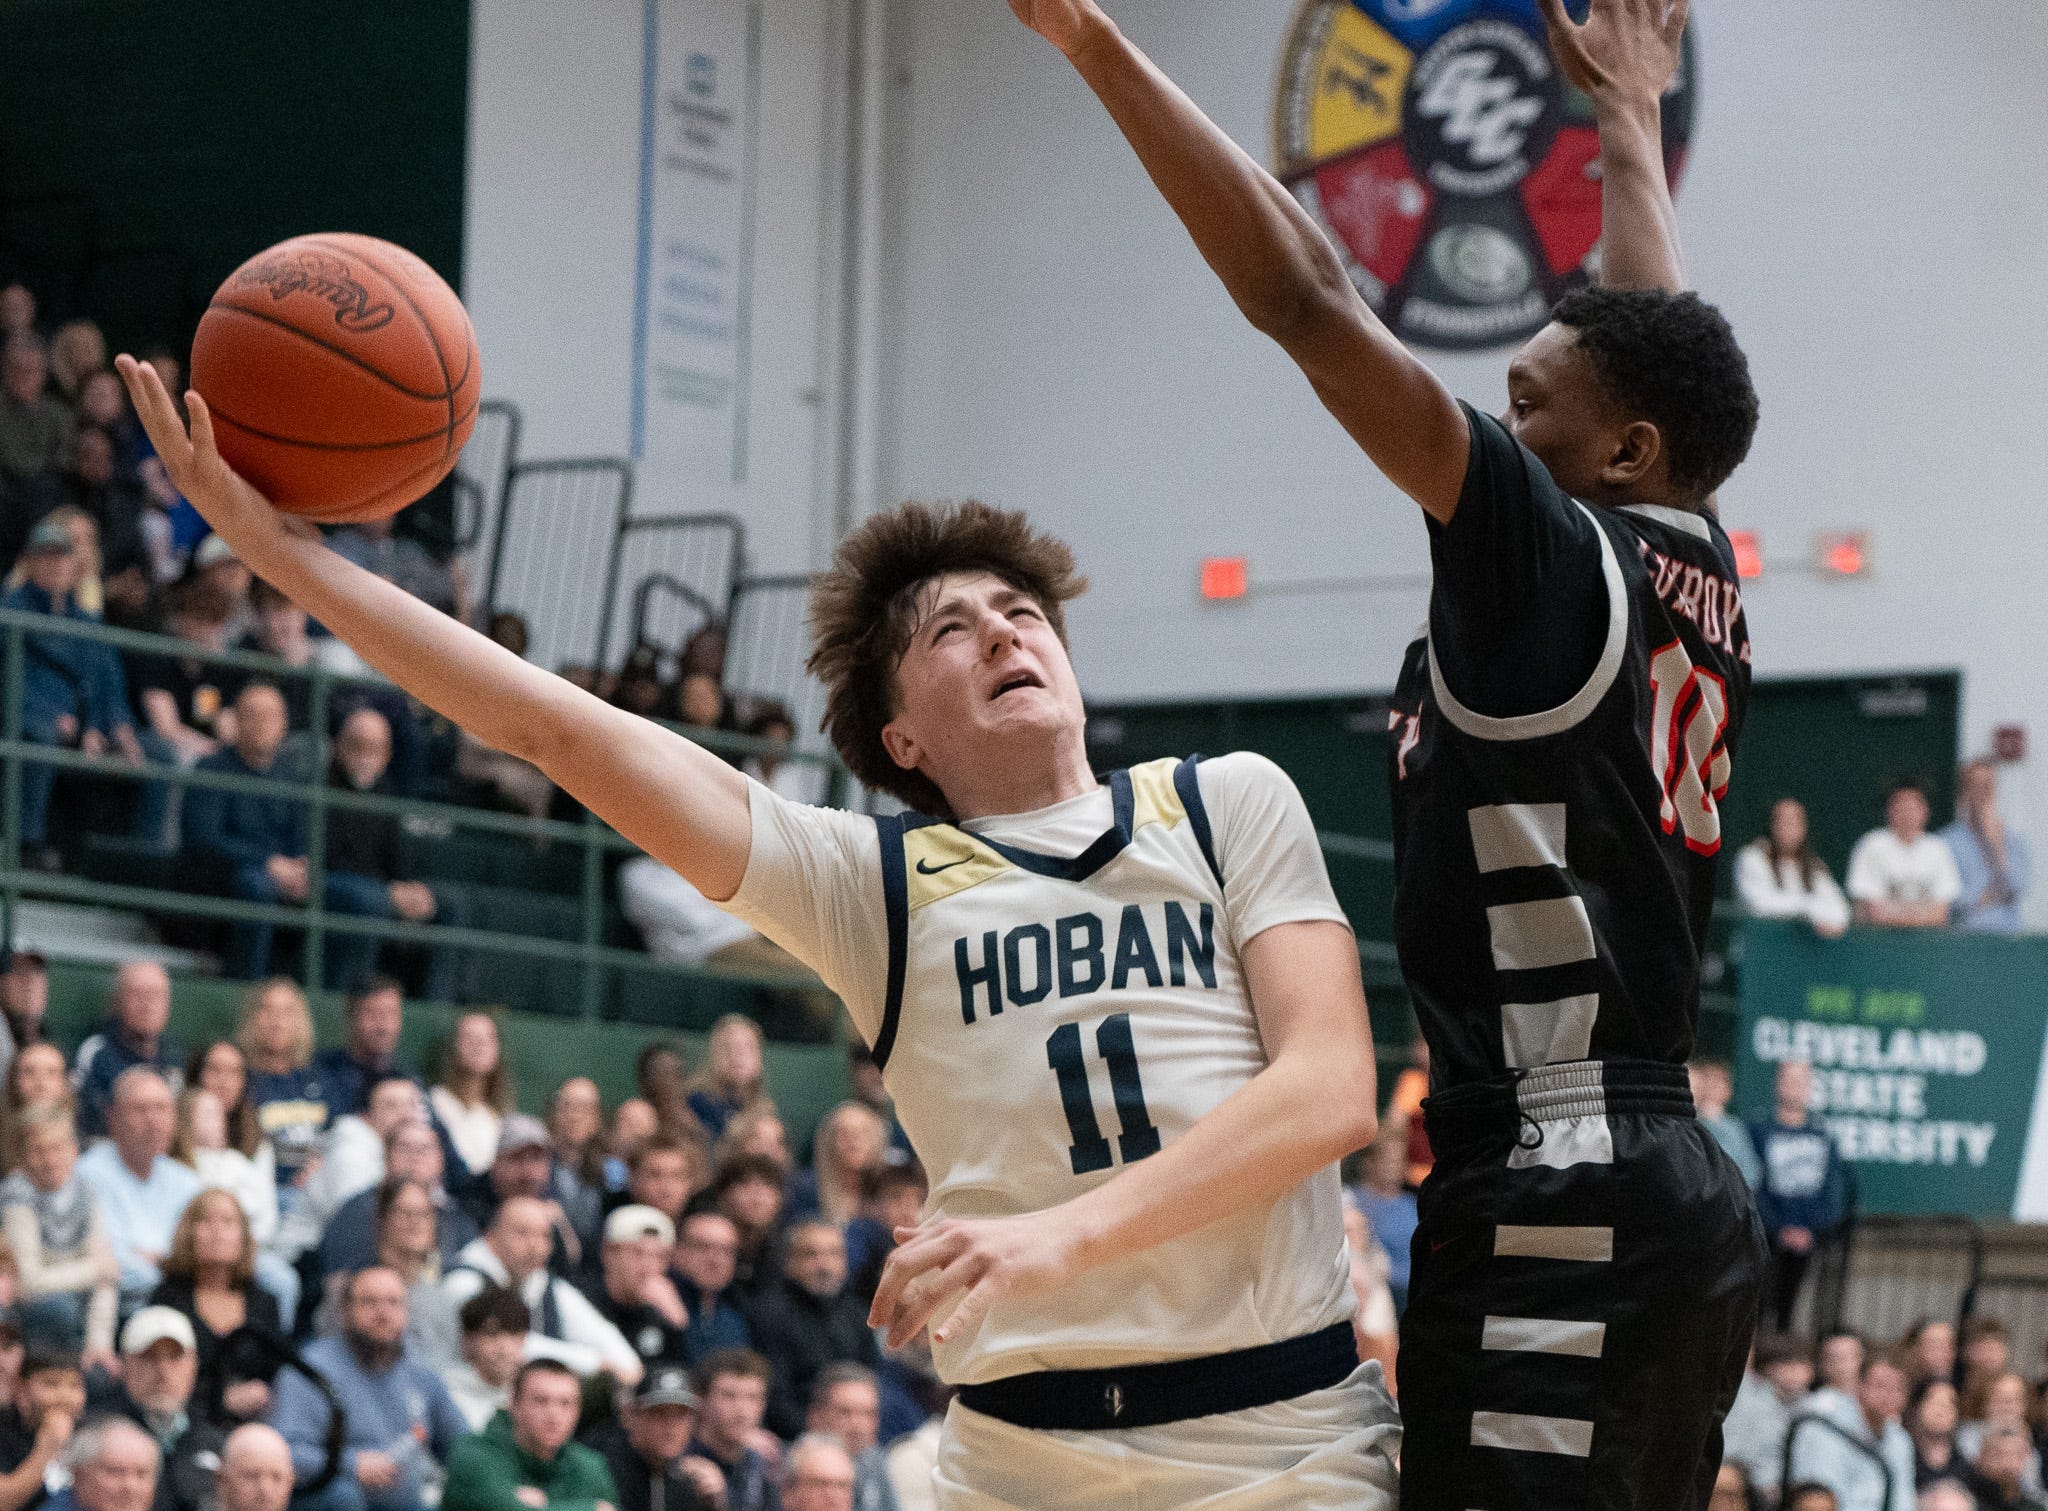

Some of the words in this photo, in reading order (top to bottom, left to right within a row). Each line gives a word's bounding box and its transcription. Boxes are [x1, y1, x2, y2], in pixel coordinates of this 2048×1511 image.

[236, 252, 395, 333] Rawl
[1650, 637, 1732, 857] 10
[954, 900, 1219, 1026] HOBAN
[1046, 1012, 1162, 1176] 11
[1753, 1015, 1988, 1076] CLEVELAND
